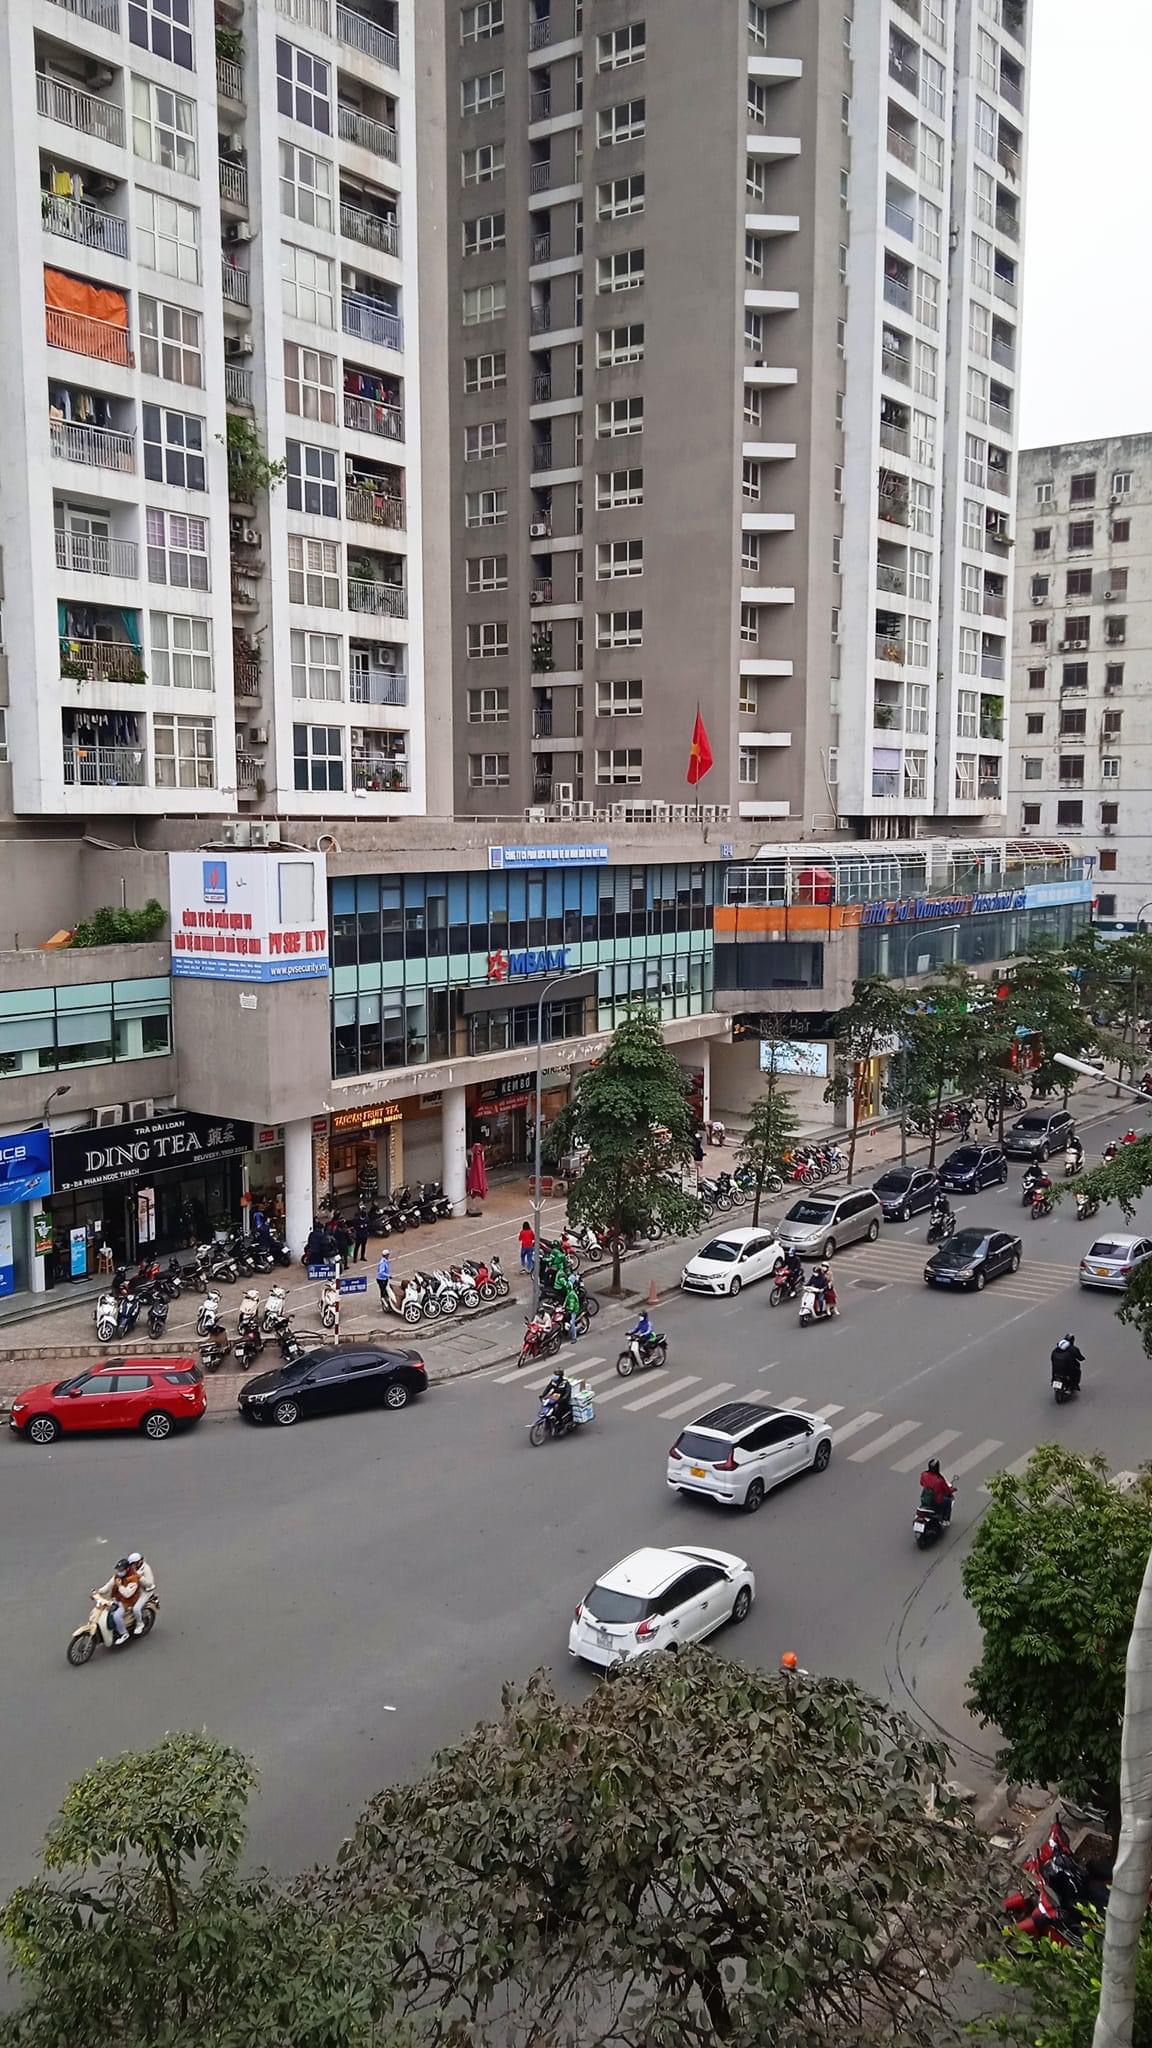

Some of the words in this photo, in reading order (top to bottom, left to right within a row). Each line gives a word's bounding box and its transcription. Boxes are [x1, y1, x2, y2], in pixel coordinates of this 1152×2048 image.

[165, 1120, 185, 1131] LOAN
[0, 1145, 26, 1161] CB
[85, 1141, 151, 1172] DING
[153, 1132, 202, 1158] TEA
